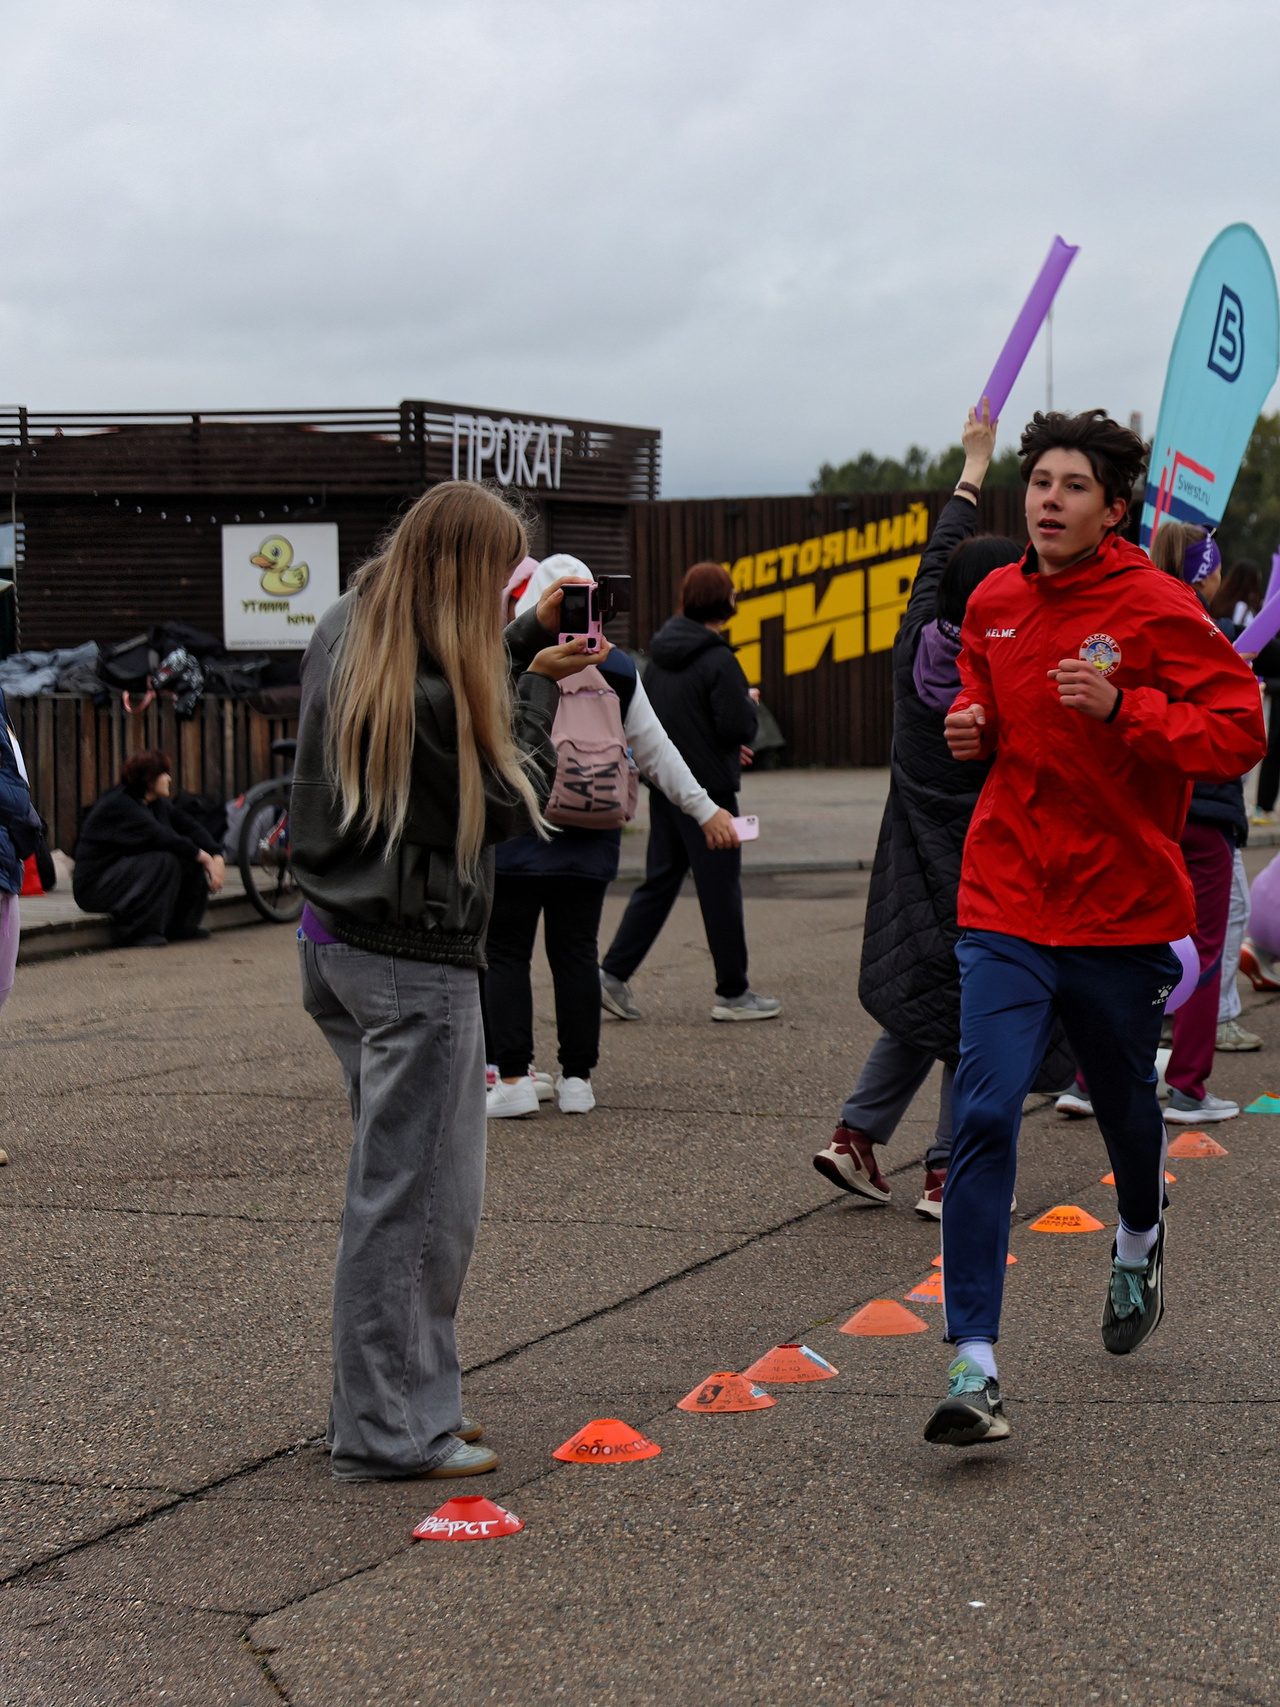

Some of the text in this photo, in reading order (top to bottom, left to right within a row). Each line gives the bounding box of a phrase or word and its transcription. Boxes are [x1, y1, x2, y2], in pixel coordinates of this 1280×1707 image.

[452, 413, 570, 490] ПРОКАТ
[721, 502, 928, 592] АСТОЯЩИЙ
[985, 628, 1016, 638] KELME
[1084, 633, 1117, 649] РАССВЕТ
[559, 757, 593, 812] LAN
[592, 762, 621, 812] VIN
